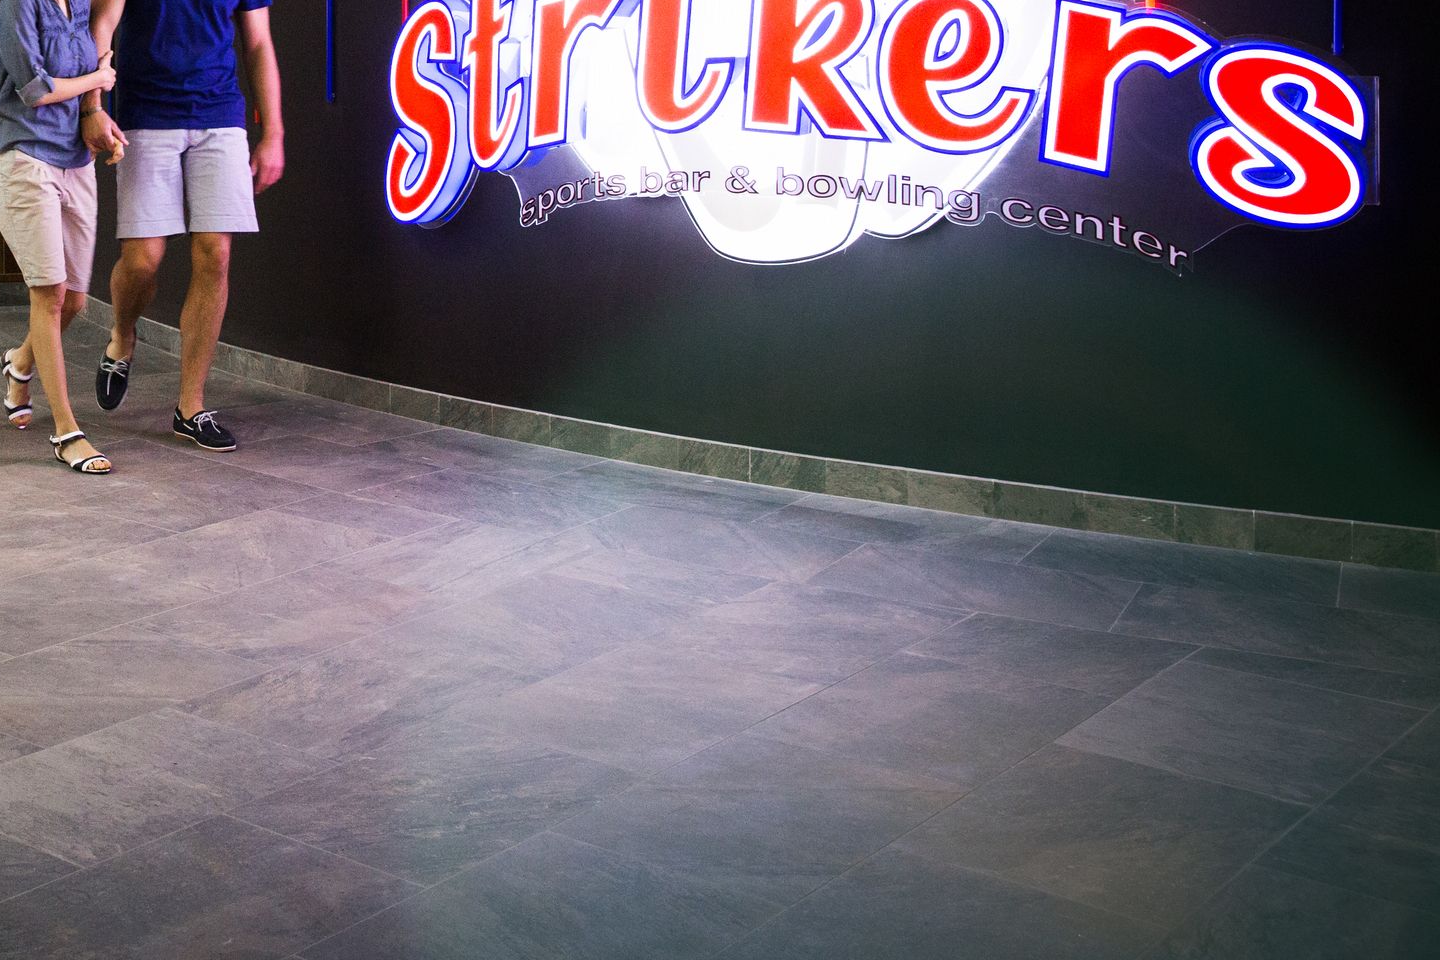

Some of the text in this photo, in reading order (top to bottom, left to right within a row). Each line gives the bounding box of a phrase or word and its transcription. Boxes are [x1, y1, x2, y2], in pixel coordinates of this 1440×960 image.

[521, 165, 1188, 268] sports bar & bowling center
